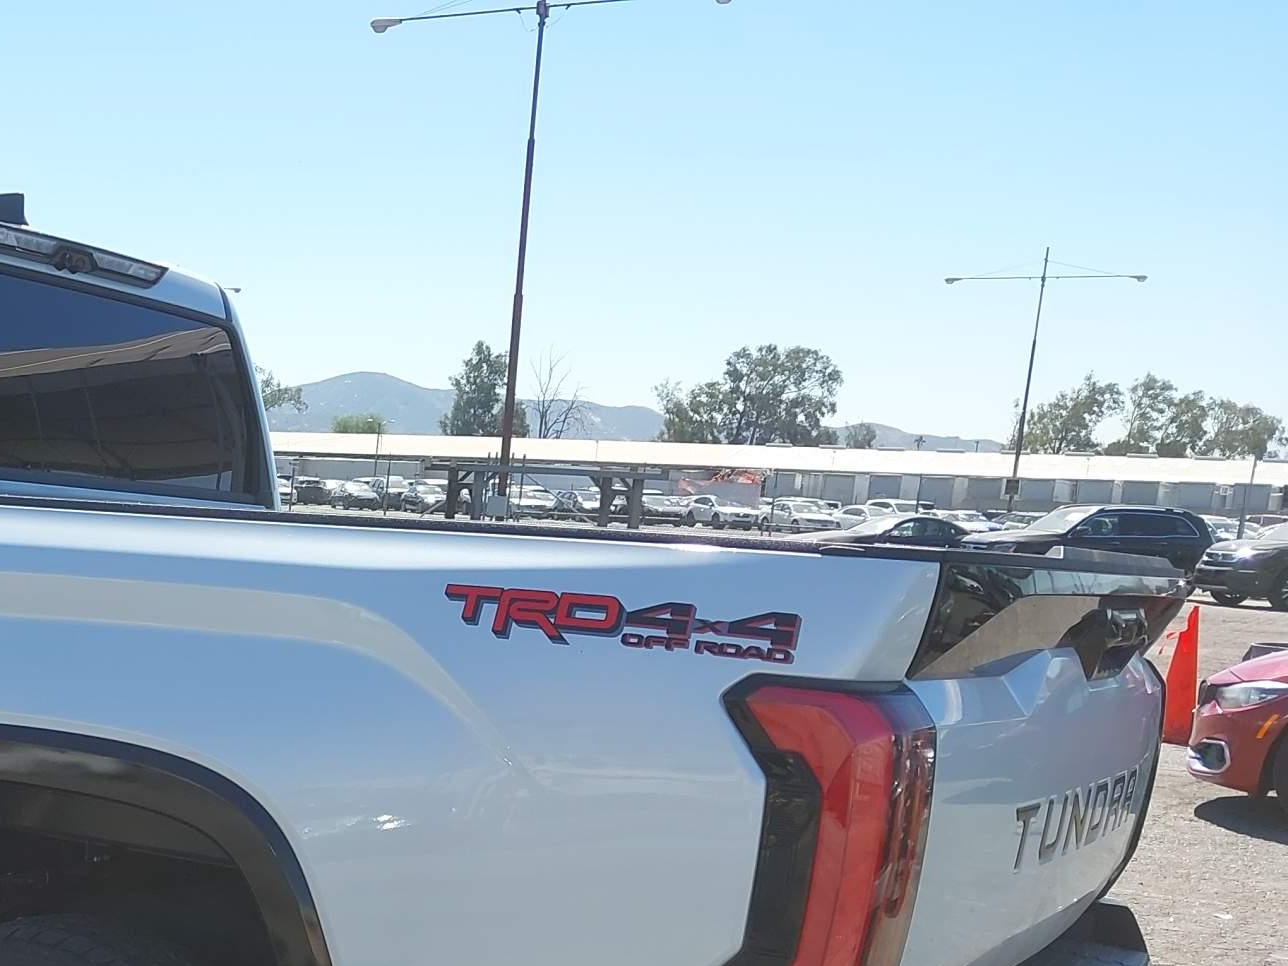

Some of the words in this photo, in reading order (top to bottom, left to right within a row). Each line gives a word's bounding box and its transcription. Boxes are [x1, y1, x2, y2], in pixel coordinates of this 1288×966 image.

[445, 584, 627, 646] TRD
[625, 601, 802, 651] 4x4
[621, 633, 689, 652] OFF
[694, 640, 795, 665] ROAD
[1013, 766, 1139, 873] TUNDRA
